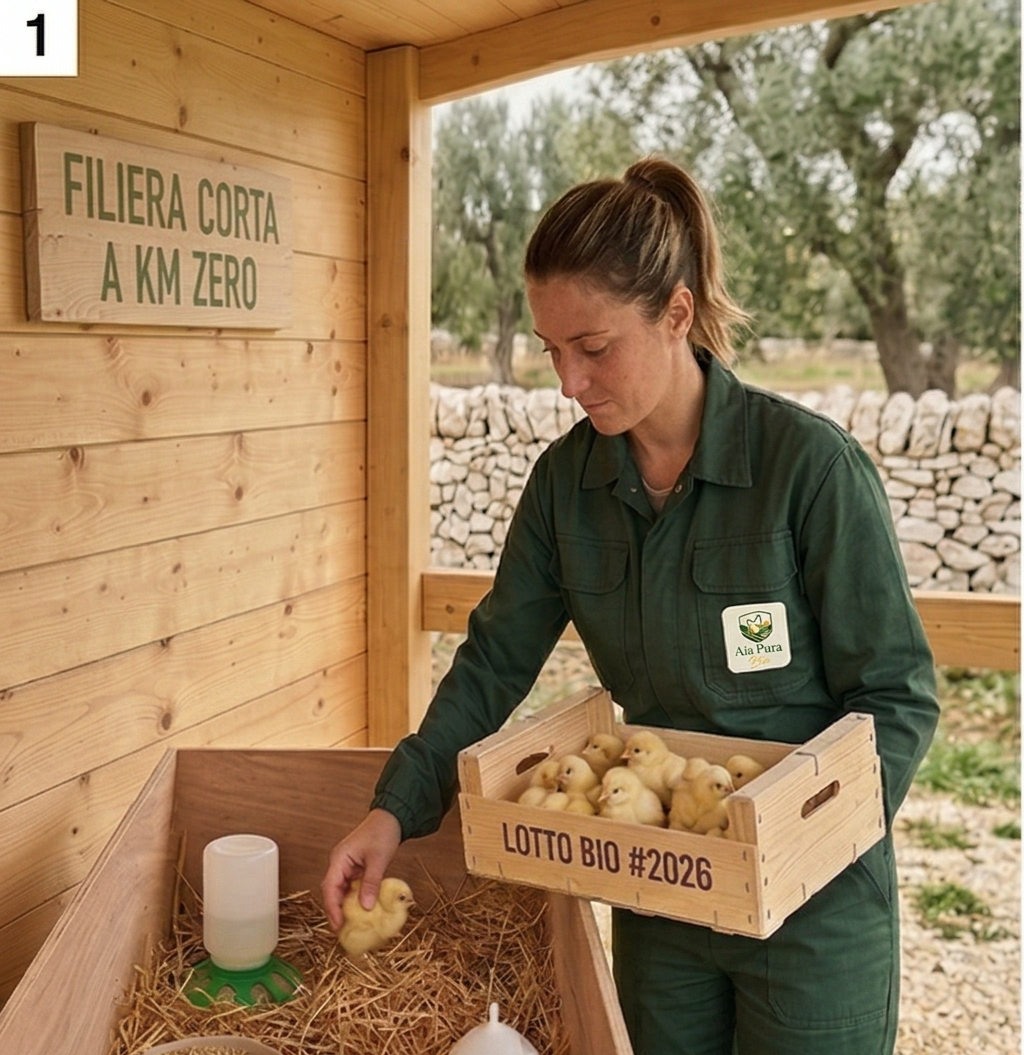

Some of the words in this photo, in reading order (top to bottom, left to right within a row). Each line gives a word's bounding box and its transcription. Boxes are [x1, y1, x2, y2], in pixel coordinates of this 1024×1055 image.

[64, 152, 187, 231] FILIERA
[198, 178, 279, 244] CORTA
[101, 241, 123, 302] A
[136, 244, 181, 305] KM
[192, 250, 257, 310] ZERO
[735, 646, 754, 656] Aia
[756, 643, 783, 654] Pura
[502, 822, 572, 864] LOTTO
[580, 836, 620, 873] BIO
[629, 846, 713, 891] #2026
